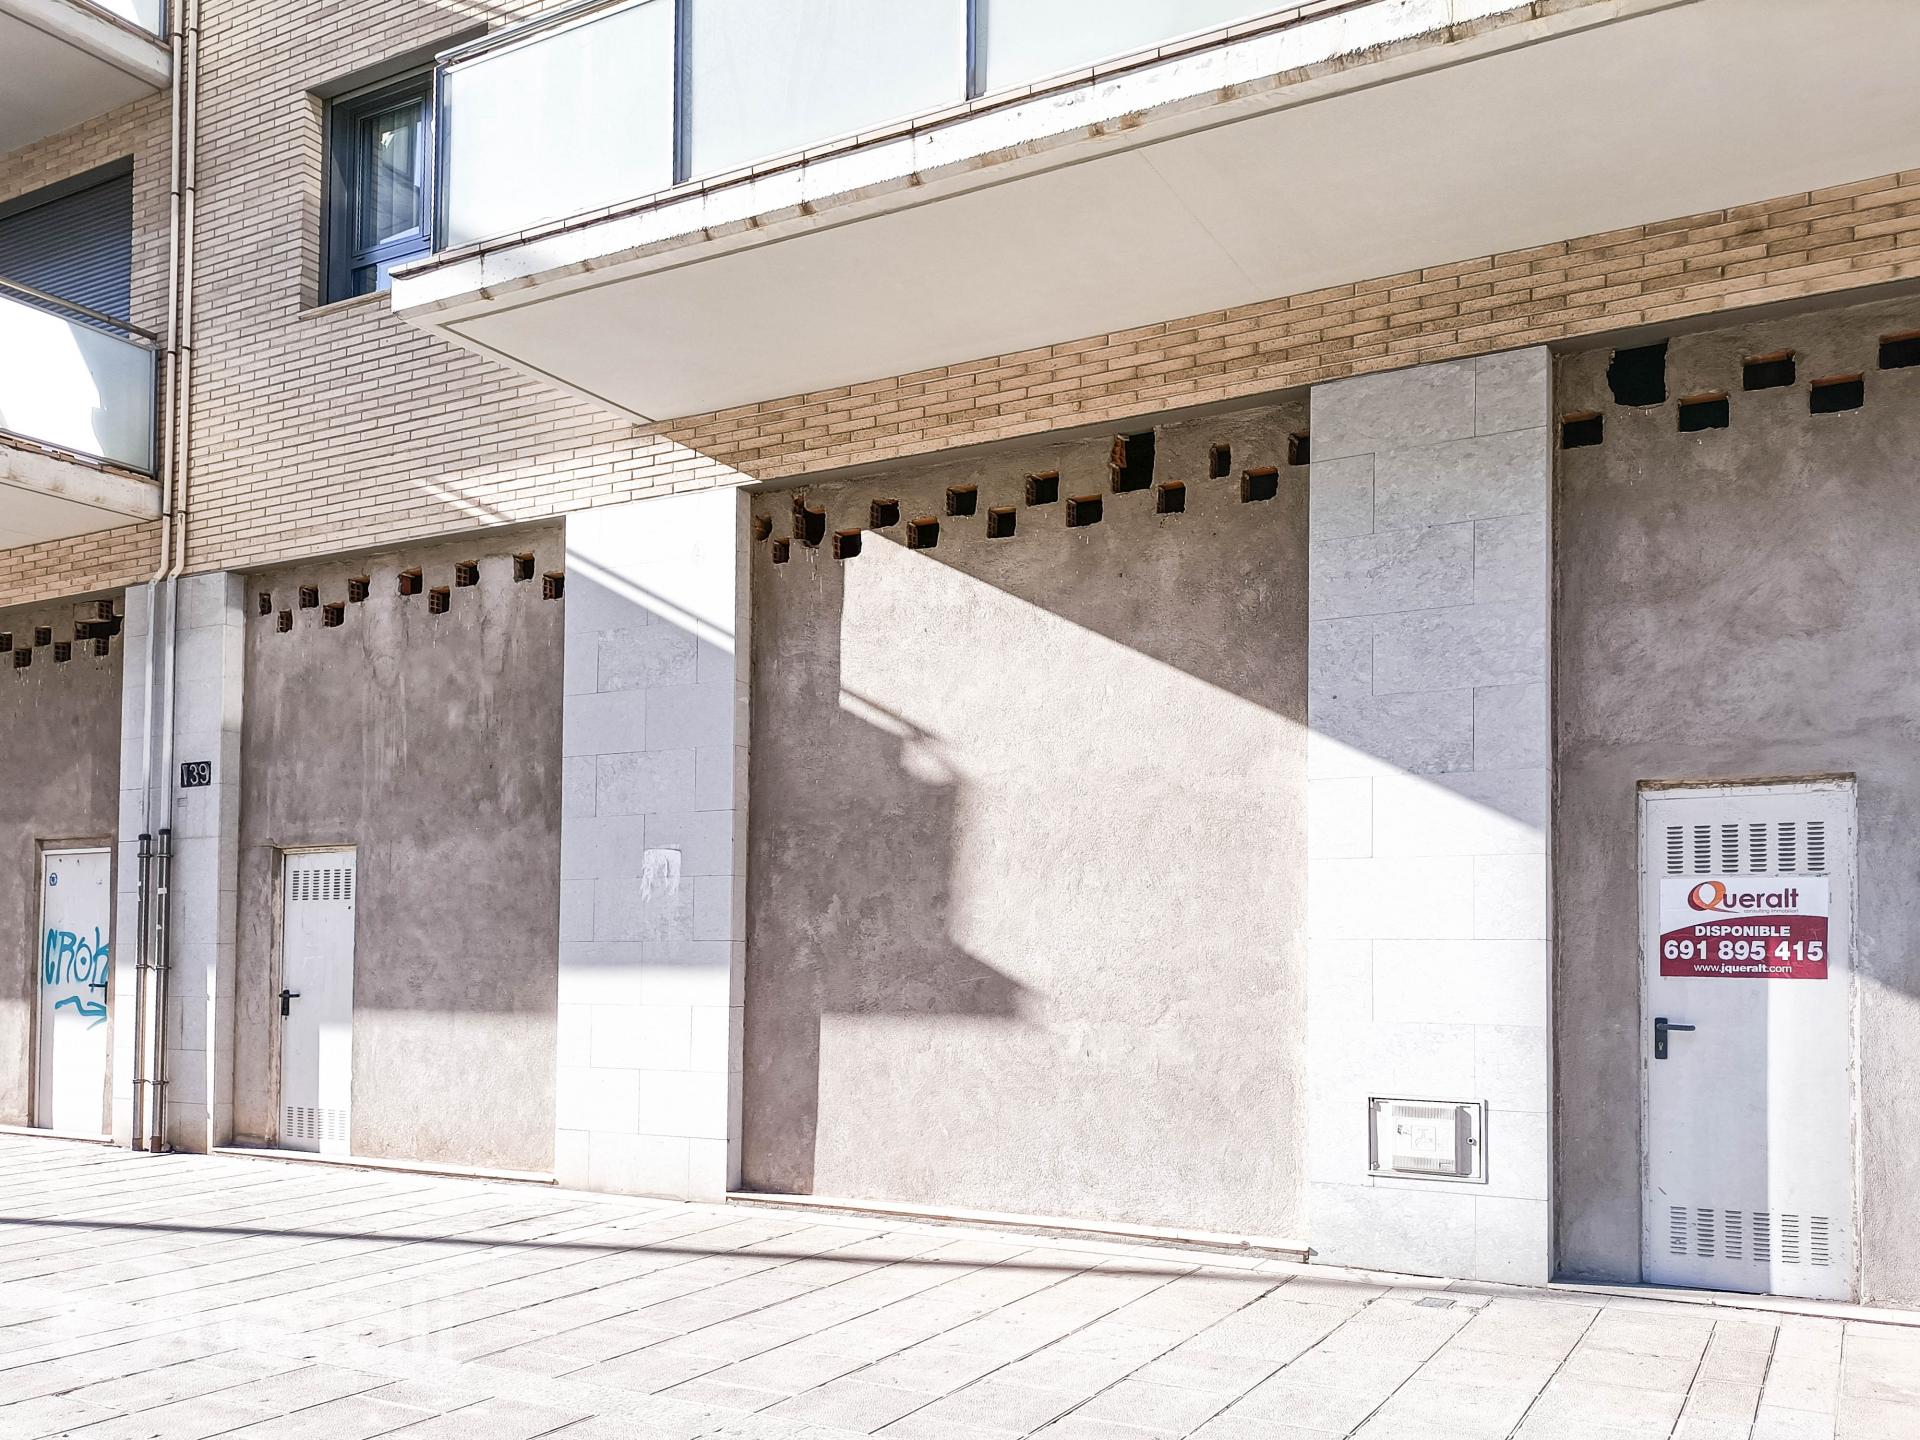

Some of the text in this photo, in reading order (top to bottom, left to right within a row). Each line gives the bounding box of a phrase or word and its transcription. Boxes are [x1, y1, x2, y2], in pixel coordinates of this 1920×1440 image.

[182, 763, 210, 786] 139
[1687, 880, 1799, 914] Queralt
[1694, 925, 1791, 937] DISPONIBLE
[1664, 939, 1824, 961] 691 895 415
[1693, 963, 1792, 973] www.jqueralt.com
